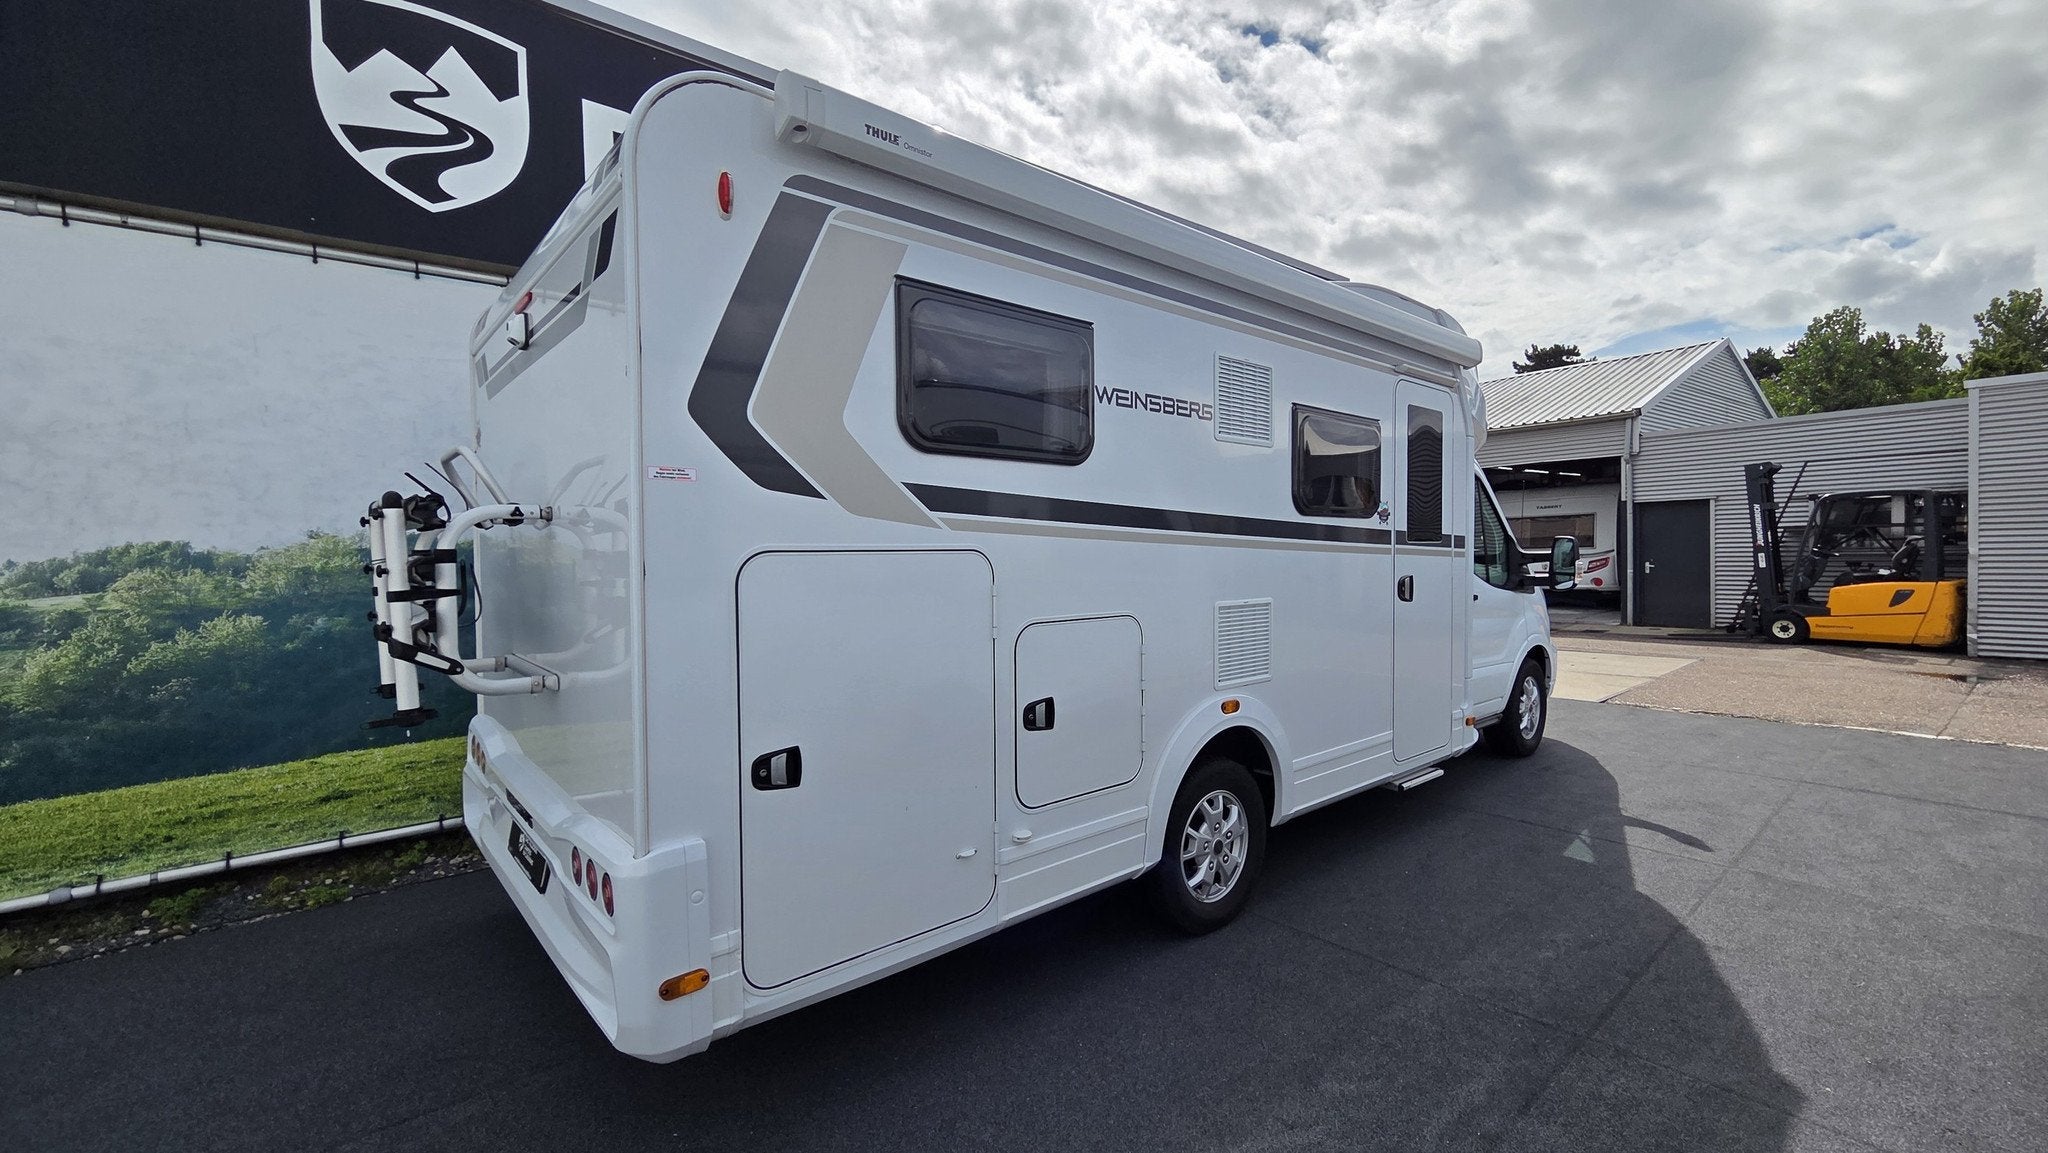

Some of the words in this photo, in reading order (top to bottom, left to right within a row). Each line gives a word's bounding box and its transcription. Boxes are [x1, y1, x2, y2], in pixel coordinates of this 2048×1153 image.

[865, 124, 900, 146] THULE
[903, 142, 933, 158] Omnistor
[1095, 385, 1213, 421] WEINSBERG
